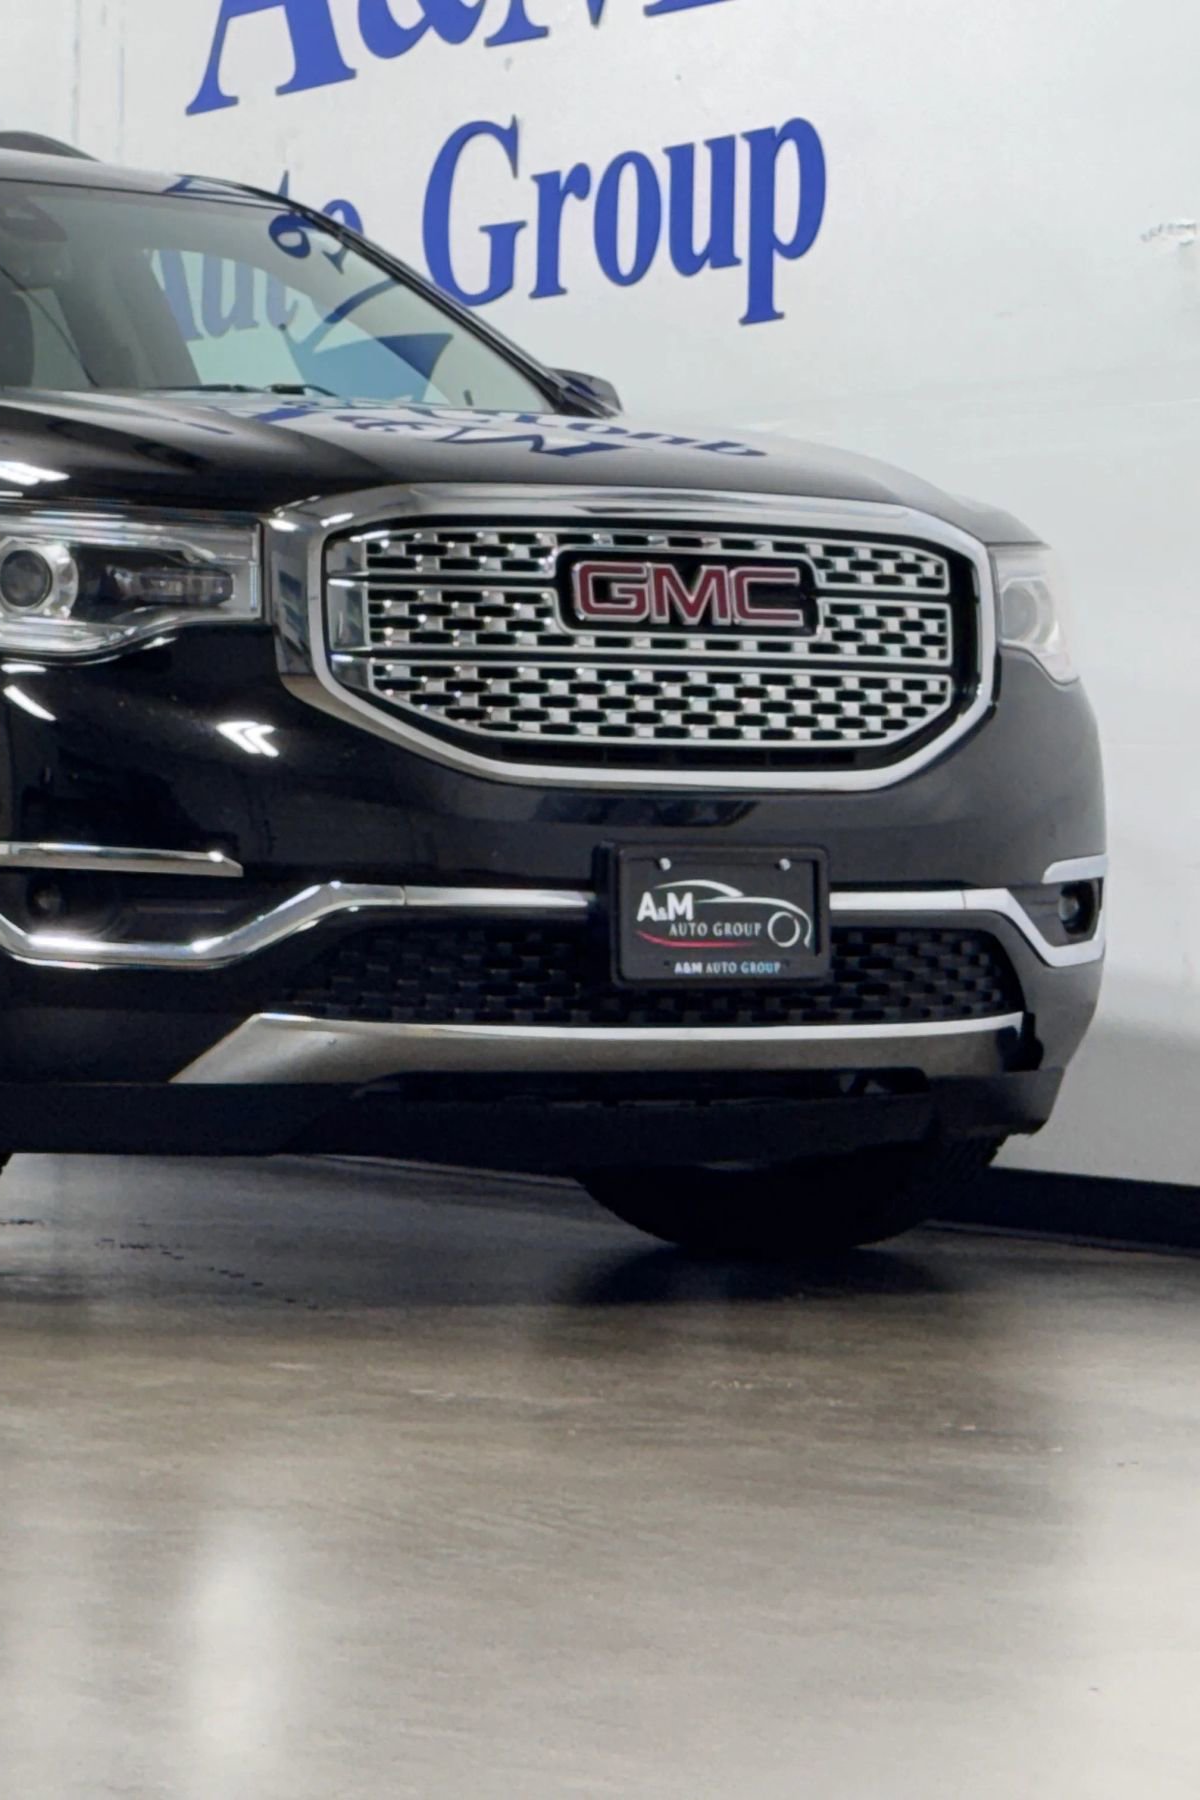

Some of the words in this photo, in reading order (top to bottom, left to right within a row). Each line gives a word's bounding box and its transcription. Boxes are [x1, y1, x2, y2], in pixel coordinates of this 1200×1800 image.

[421, 114, 827, 325] Group
[573, 561, 804, 627] GMC
[636, 891, 695, 922] A&M
[669, 922, 708, 937] AUTO
[712, 922, 762, 937] GROUP
[705, 962, 738, 974] AUTO
[740, 962, 781, 974] GROUP
